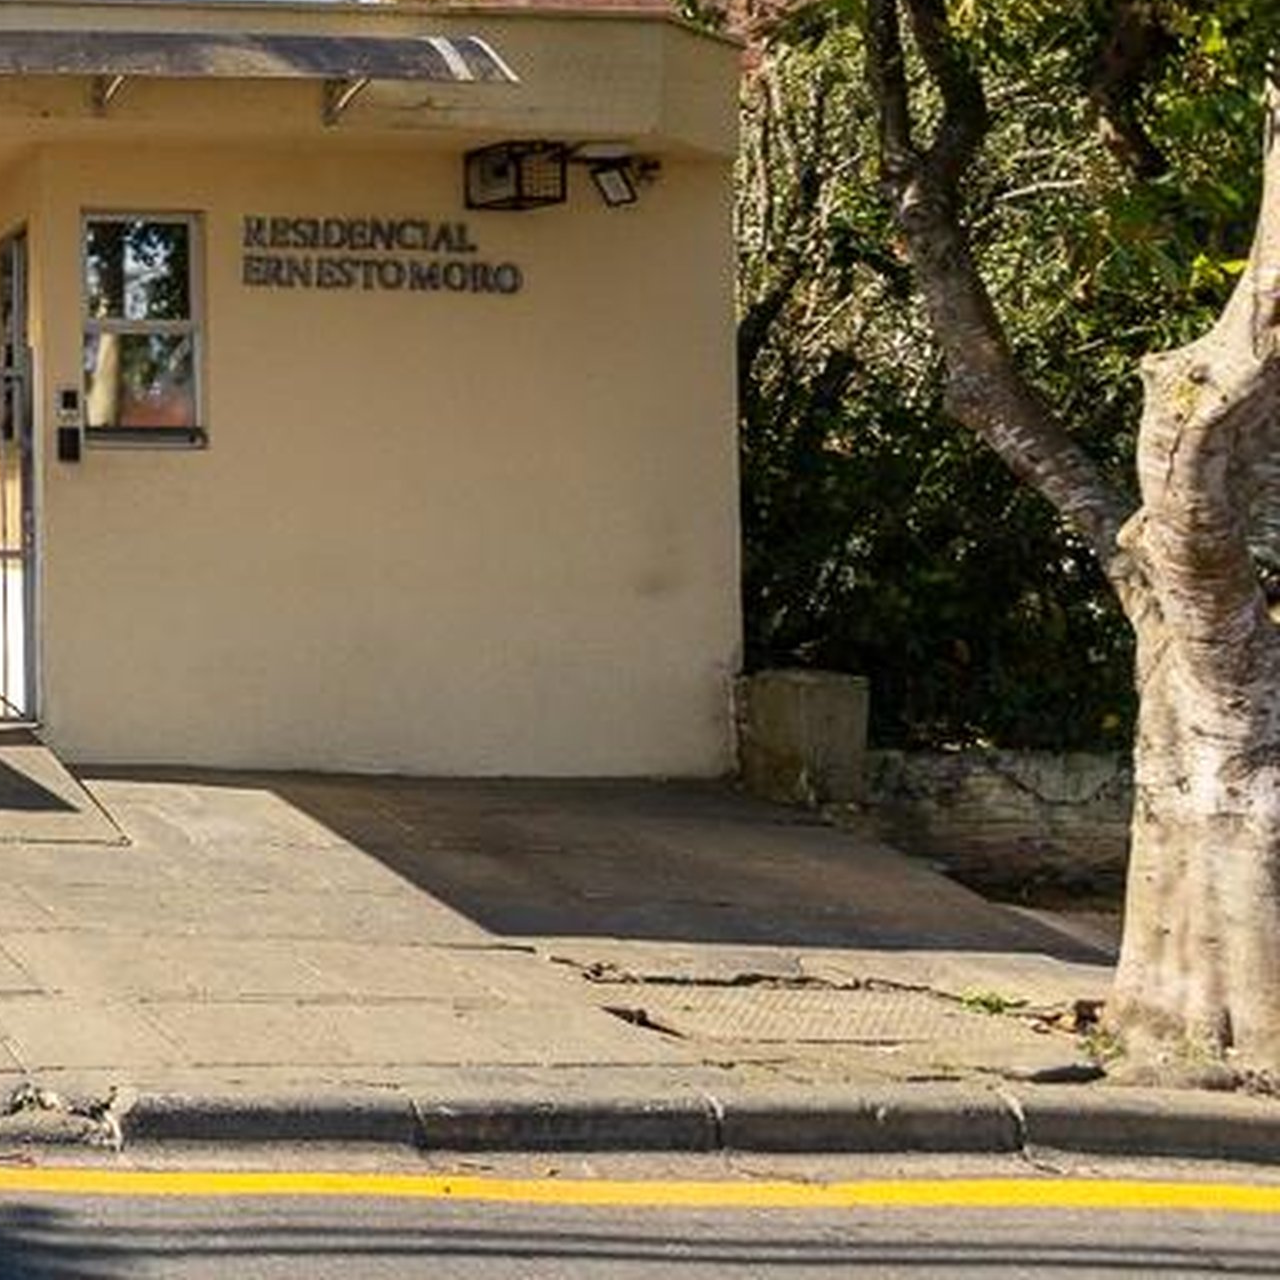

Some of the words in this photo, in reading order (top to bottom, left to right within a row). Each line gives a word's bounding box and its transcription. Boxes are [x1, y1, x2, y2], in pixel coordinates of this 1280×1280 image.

[242, 215, 477, 253] RESIDENCIAL
[242, 254, 407, 290] ERNESTO
[409, 260, 524, 295] MORO
